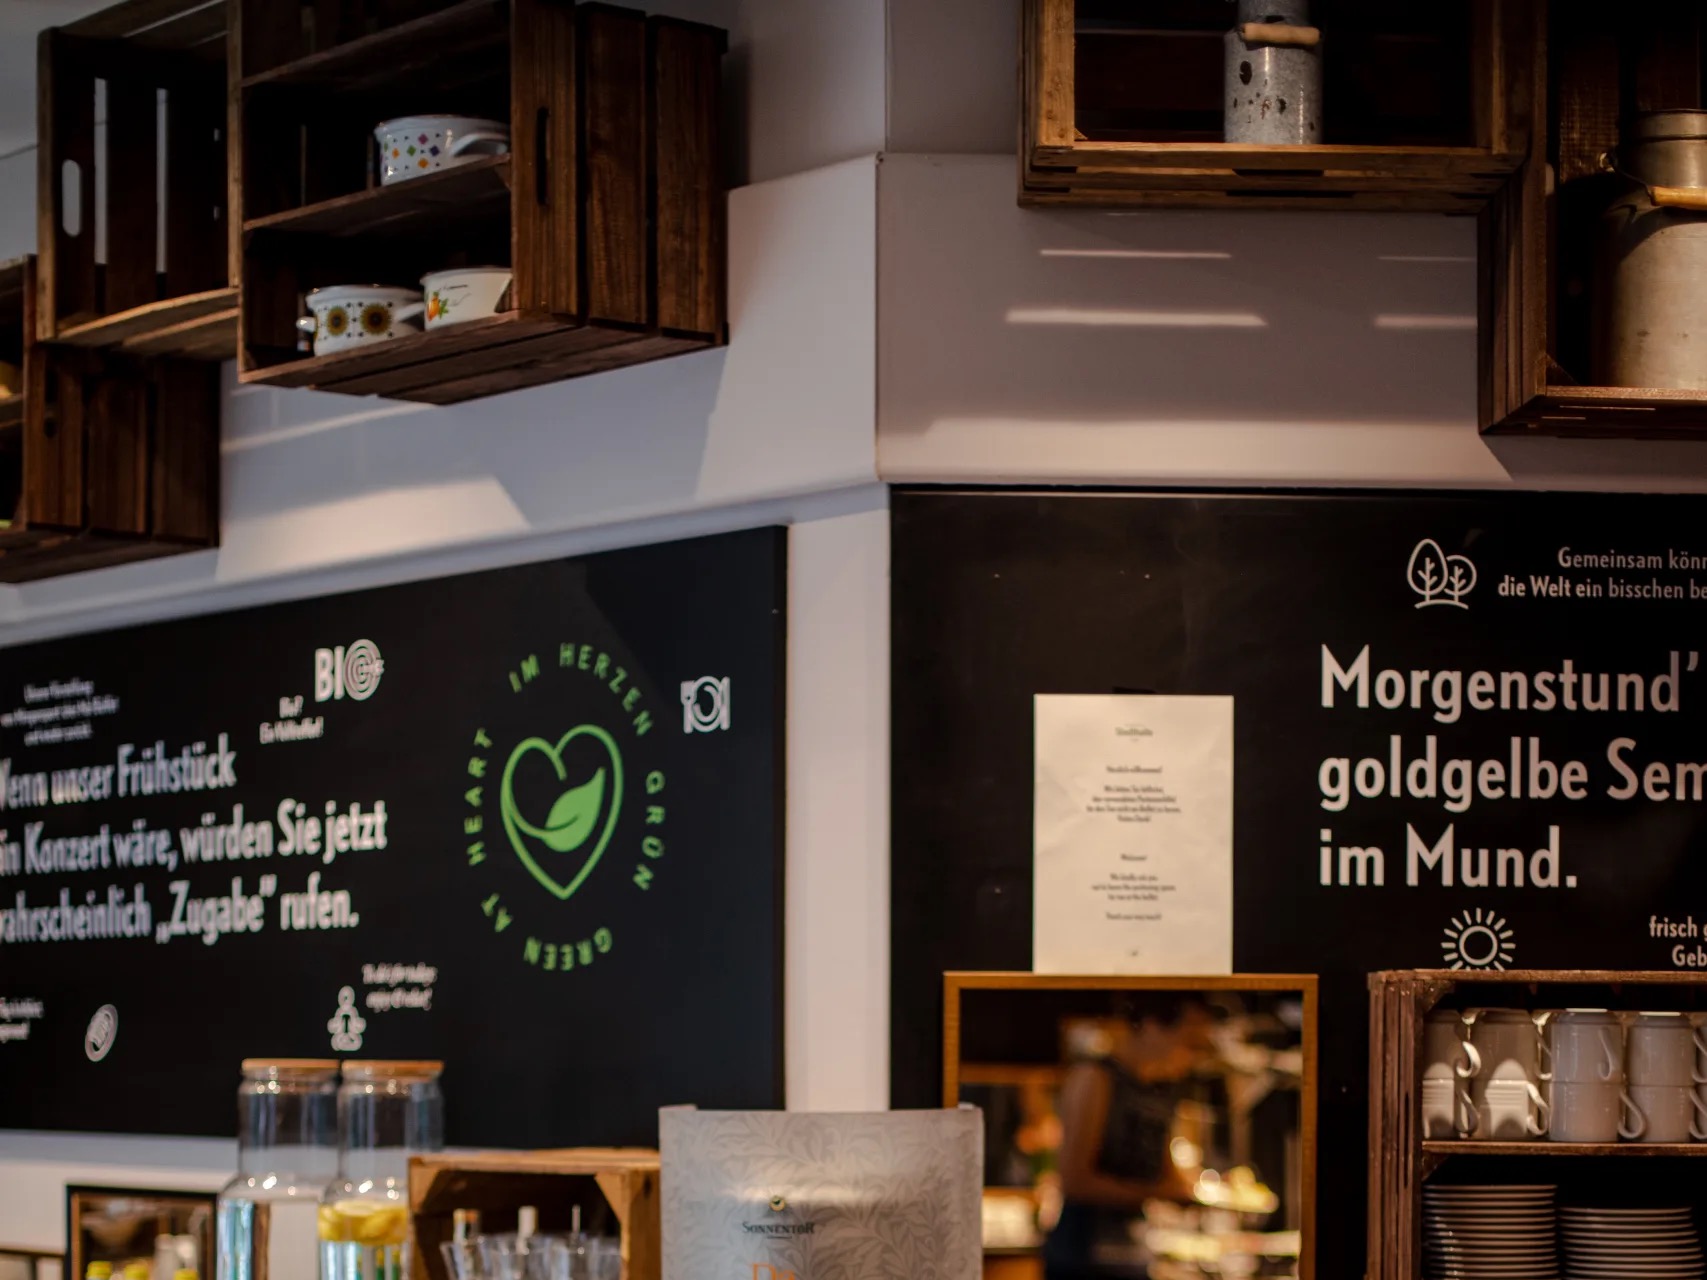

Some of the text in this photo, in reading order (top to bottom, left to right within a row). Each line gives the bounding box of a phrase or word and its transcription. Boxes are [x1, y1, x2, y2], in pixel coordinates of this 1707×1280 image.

[1498, 574, 1527, 598] die
[1529, 574, 1571, 598] Welt
[1575, 578, 1603, 598] ein
[1608, 577, 1684, 599] bisschen
[1557, 546, 1663, 570] Gemeinsam
[508, 654, 540, 693] IM
[559, 642, 653, 736] HERZEN
[51, 764, 114, 805] unser
[117, 732, 237, 798] Frühstück
[1318, 734, 1589, 813] goldgelbe
[24, 820, 112, 875] Konzert
[112, 818, 178, 873] wäre,
[180, 803, 274, 863] würden
[277, 798, 322, 857] Sie
[322, 800, 388, 864] jetzt
[464, 728, 613, 971] GREEN AT HEART
[1320, 822, 1578, 888] im Mund.
[0, 882, 152, 944] ahrscheinlich
[280, 871, 360, 931] rufen.
[1649, 914, 1698, 938] frisch
